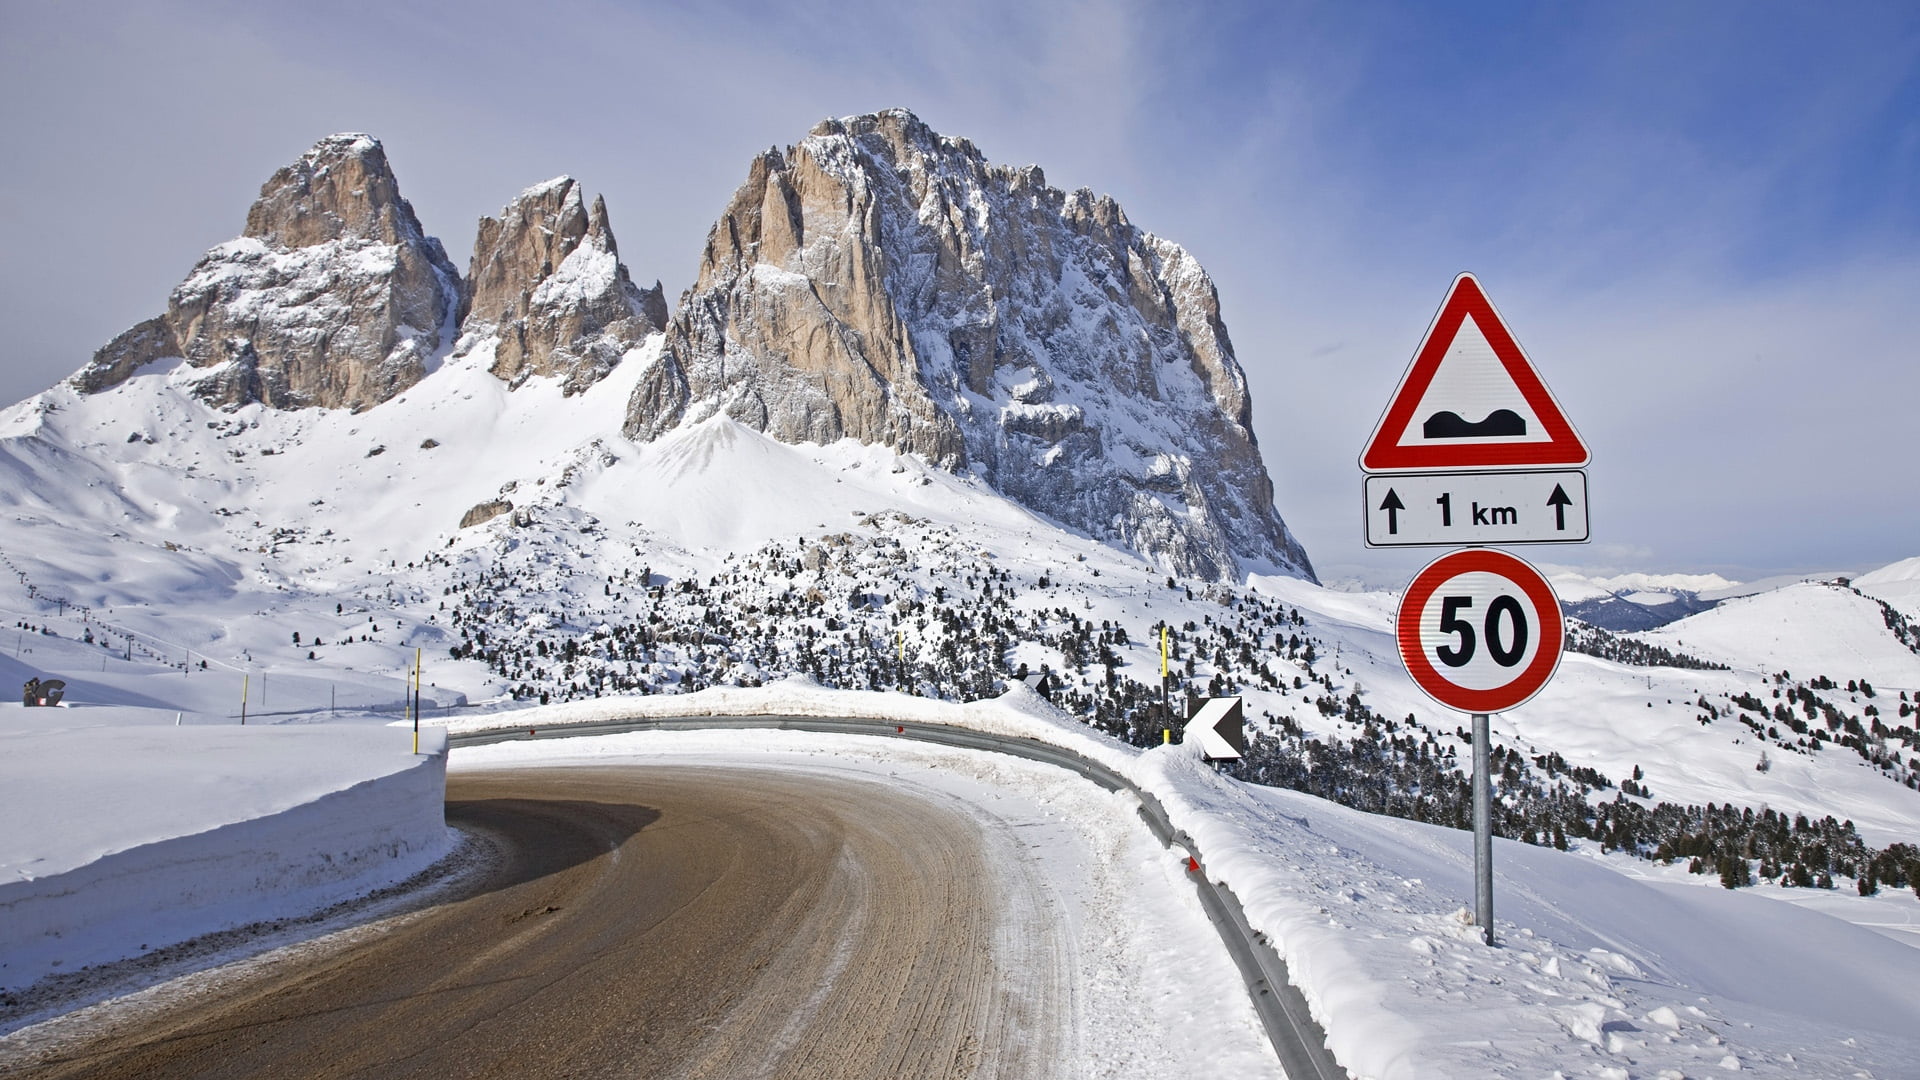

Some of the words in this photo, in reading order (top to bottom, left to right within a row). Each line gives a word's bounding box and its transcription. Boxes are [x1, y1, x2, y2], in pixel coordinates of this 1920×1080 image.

[1436, 492, 1452, 527] 1
[1471, 501, 1518, 526] km
[1435, 594, 1529, 668] 50
